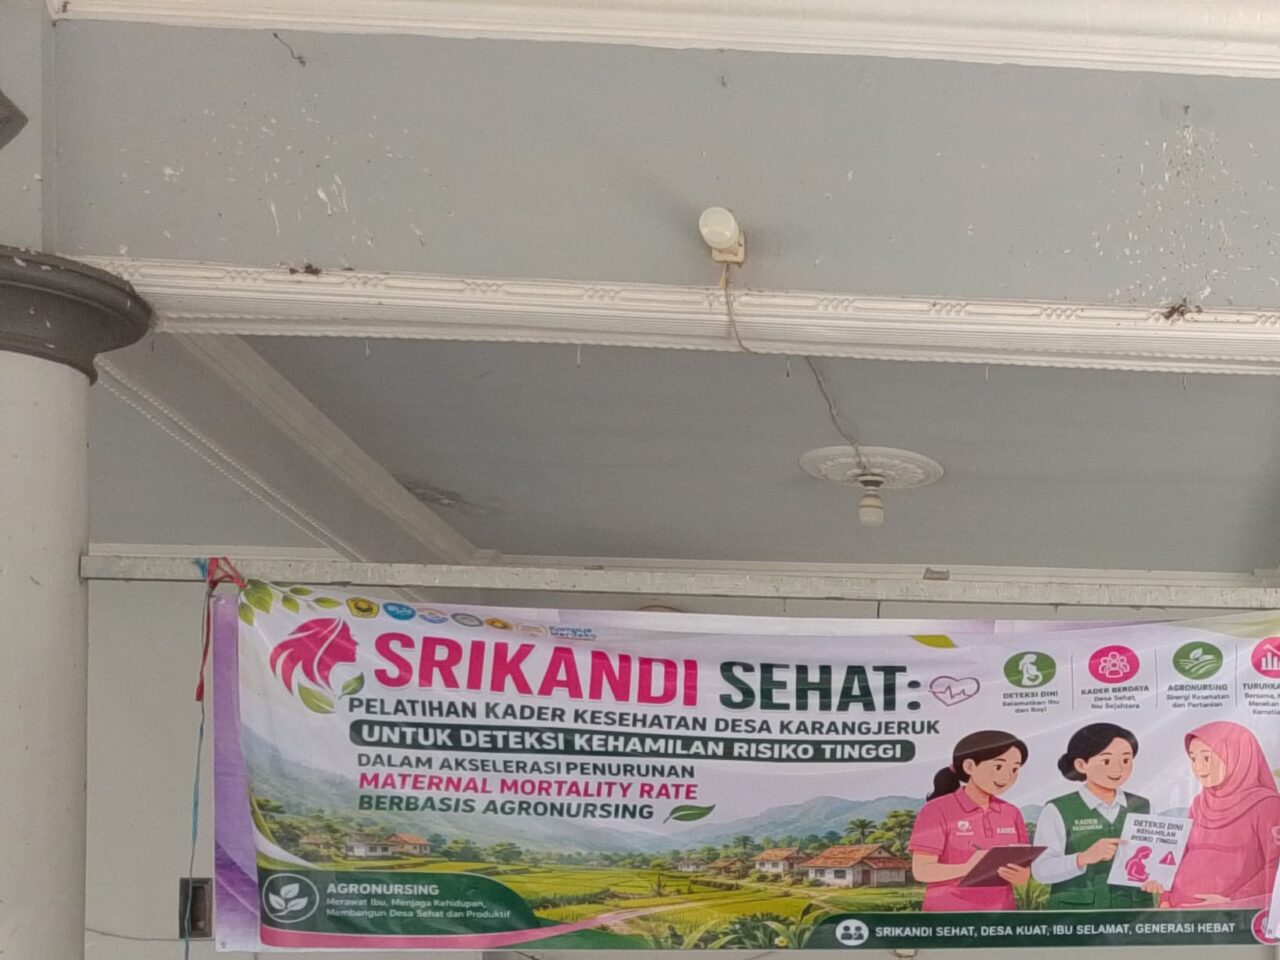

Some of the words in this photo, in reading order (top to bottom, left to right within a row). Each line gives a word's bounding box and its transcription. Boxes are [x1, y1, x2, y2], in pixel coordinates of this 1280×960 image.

[374, 632, 698, 706] SRIKANDI
[719, 661, 921, 712] SEHAT:
[1003, 691, 1039, 699] DETEKSI
[1041, 690, 1059, 698] DINI
[1081, 688, 1109, 696] KADER
[1111, 685, 1150, 693] BERDAYA
[1167, 683, 1228, 691] AGRONURSING
[348, 697, 477, 719] PELATIHAN
[485, 702, 566, 722] KADER
[573, 708, 707, 731] KESEHATAN
[714, 717, 772, 734] DESA
[779, 720, 940, 735] KARANGJERUK
[361, 724, 453, 746] UNTUK
[460, 729, 564, 750] DETEKSI
[574, 733, 723, 756] KEHAMILAN
[733, 741, 814, 759] RISIKO
[821, 743, 901, 759] TINGGI
[358, 753, 432, 769] DALAM
[438, 757, 561, 774] AKSELERASI
[566, 762, 695, 778] PENURUNAN
[358, 772, 492, 793] MATERNAL
[500, 778, 633, 798] MORTALITY
[639, 782, 698, 799] RATE
[358, 794, 475, 813] BERBASIS
[481, 799, 654, 819] AGRONURSING
[1133, 819, 1166, 830] DETEKSI
[1167, 822, 1184, 831] DINI
[326, 883, 440, 896] AGRONURSING
[326, 898, 367, 906] Merawat
[391, 899, 432, 909] Menjaga
[433, 899, 486, 909] Kehidupan,
[326, 909, 387, 919] Membangun
[389, 910, 414, 918] Desa
[416, 909, 444, 918] Sehat
[446, 910, 464, 918] dan
[466, 910, 511, 919] Produktif
[875, 926, 933, 937] SRIKANDI
[935, 926, 978, 939] SEHAT,
[981, 926, 1013, 936] DESA
[1016, 924, 1051, 937] KUAT,
[1053, 924, 1073, 935] IBU
[1076, 924, 1132, 936] SELAMAT,
[1135, 923, 1194, 934] GENERASI
[1197, 922, 1236, 933] HEBAT
